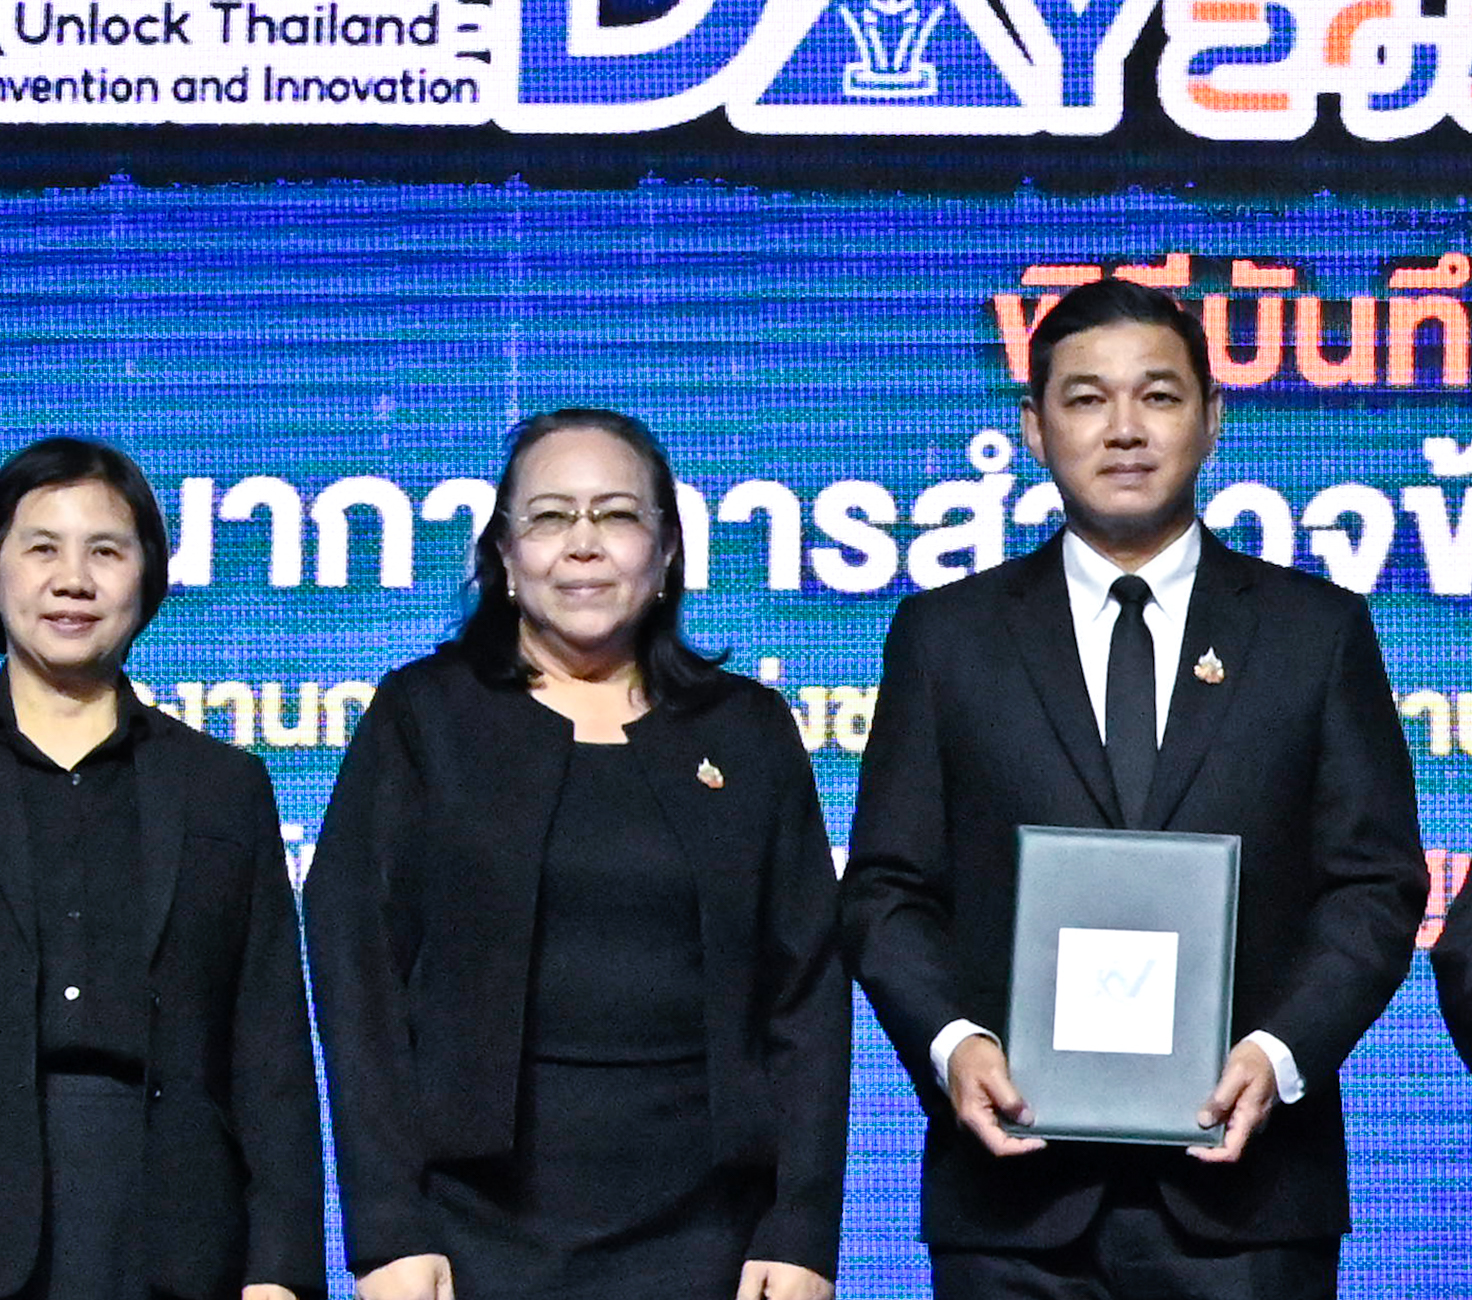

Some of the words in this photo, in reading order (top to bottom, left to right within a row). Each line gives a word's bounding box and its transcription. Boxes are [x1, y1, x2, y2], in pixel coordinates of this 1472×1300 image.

[13, 0, 191, 46] Unlock
[211, 0, 439, 46] Thailand
[171, 65, 248, 106] and
[262, 66, 479, 106] Innovation
